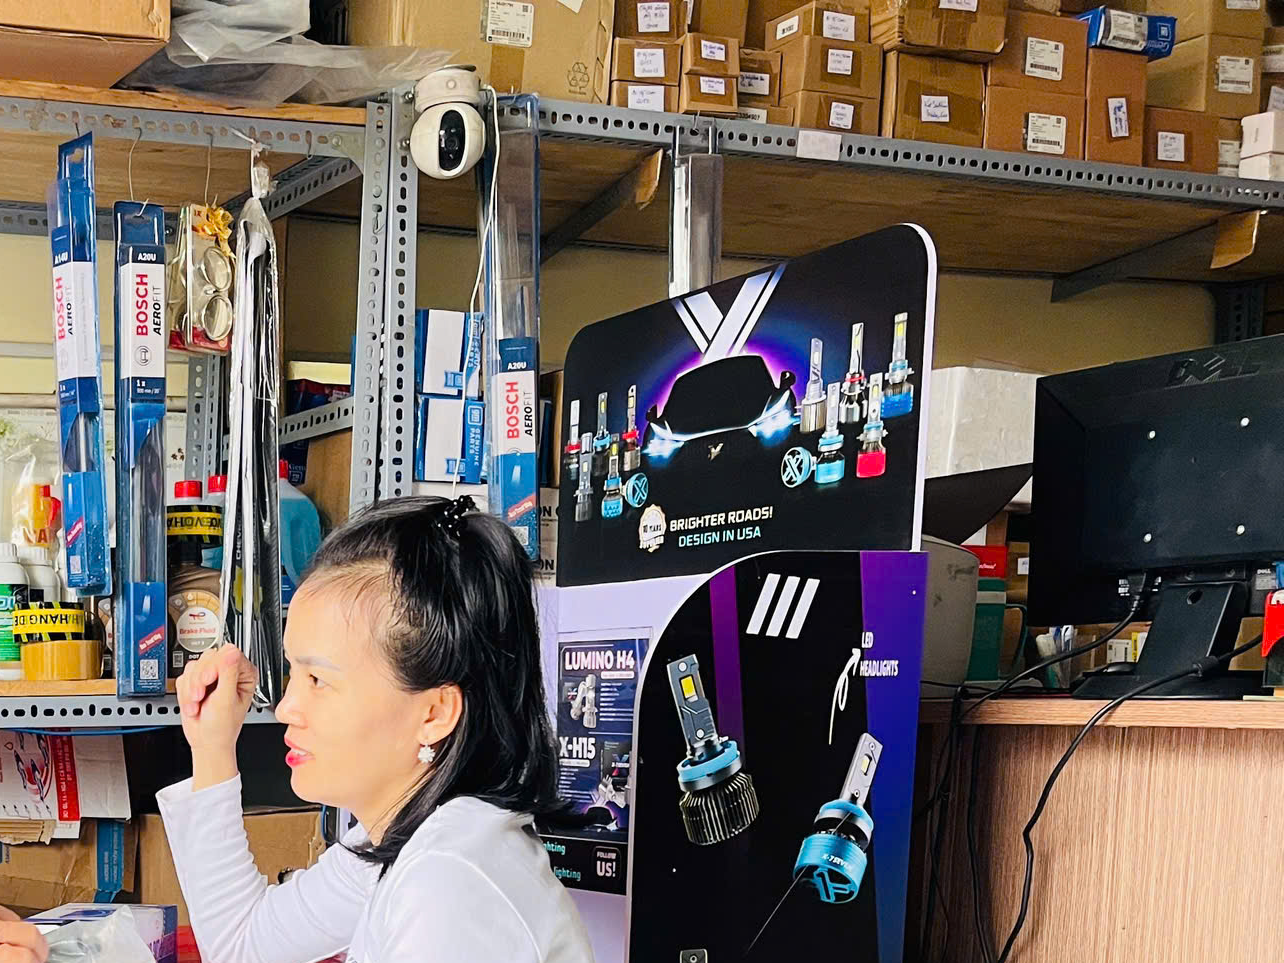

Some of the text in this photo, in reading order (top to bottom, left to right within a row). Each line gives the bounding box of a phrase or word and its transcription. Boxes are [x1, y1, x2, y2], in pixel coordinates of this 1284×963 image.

[137, 252, 157, 262] A20U
[55, 276, 65, 340] BOSCH
[136, 273, 149, 336] BOSCH
[152, 286, 162, 336] AEROFIT
[507, 362, 526, 370] A20U
[506, 381, 519, 439] BOSCH
[524, 390, 534, 437] AEROFIT
[468, 428, 476, 454] PARTS
[473, 427, 481, 466] GENUINE
[670, 506, 774, 532] BRIGHTER ROADS!
[678, 526, 762, 548] DESIGN IN USA
[862, 632, 874, 649] LED
[564, 650, 636, 671] LUMINO H4
[859, 659, 899, 677] HEADLIGHTS
[596, 850, 617, 860] FOLLOW
[596, 860, 616, 878] US!
